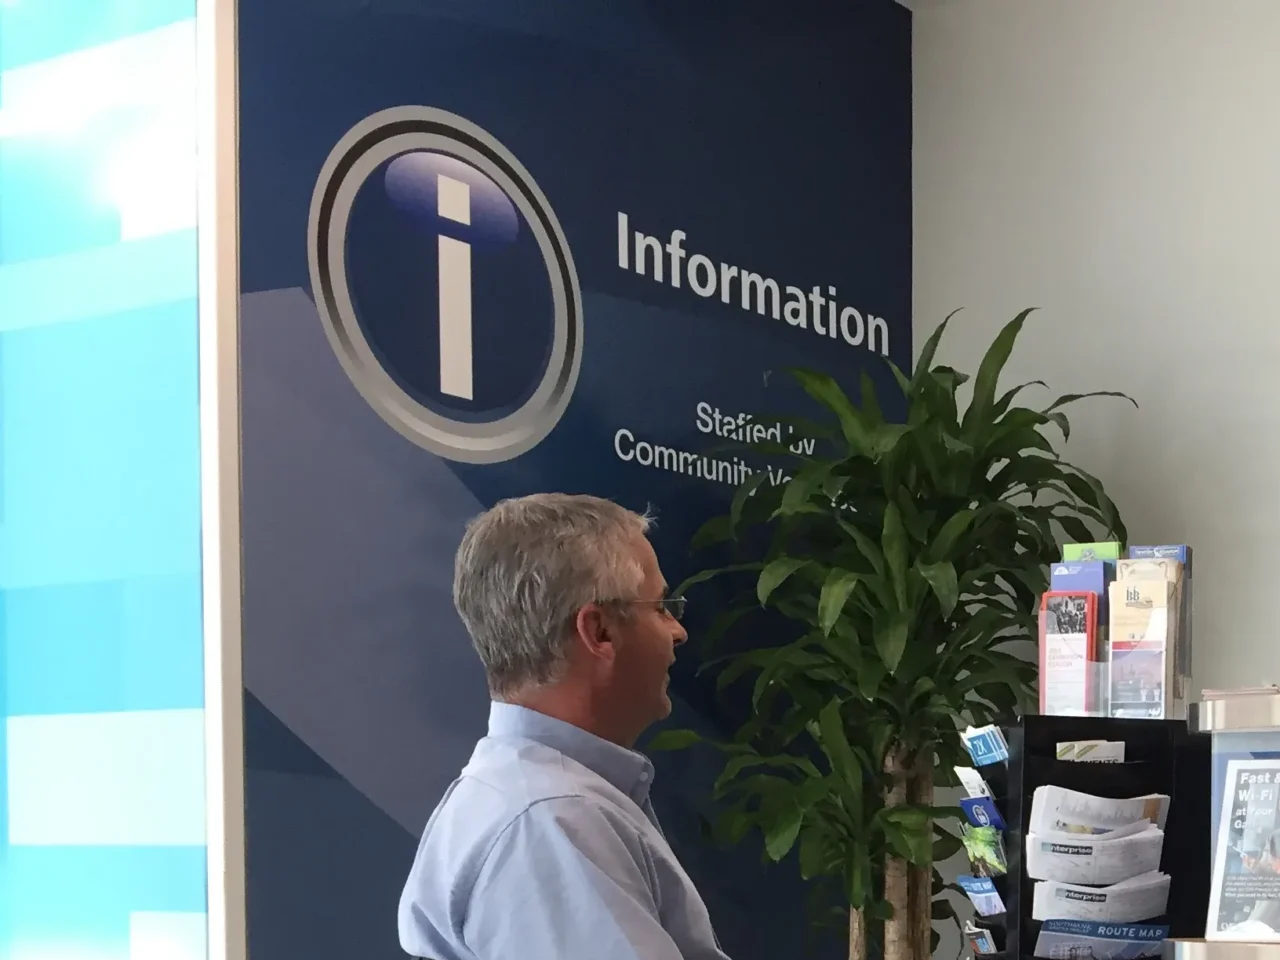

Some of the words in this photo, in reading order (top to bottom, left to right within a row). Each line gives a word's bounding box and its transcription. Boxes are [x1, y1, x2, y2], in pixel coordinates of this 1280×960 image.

[618, 211, 889, 357] Information
[614, 428, 760, 496] Communit
[1240, 772, 1271, 784] Fast
[1238, 789, 1273, 801] Wi-Fi
[1235, 807, 1246, 816] at
[1098, 926, 1136, 937] ROUTE
[1138, 928, 1164, 937] MAP
